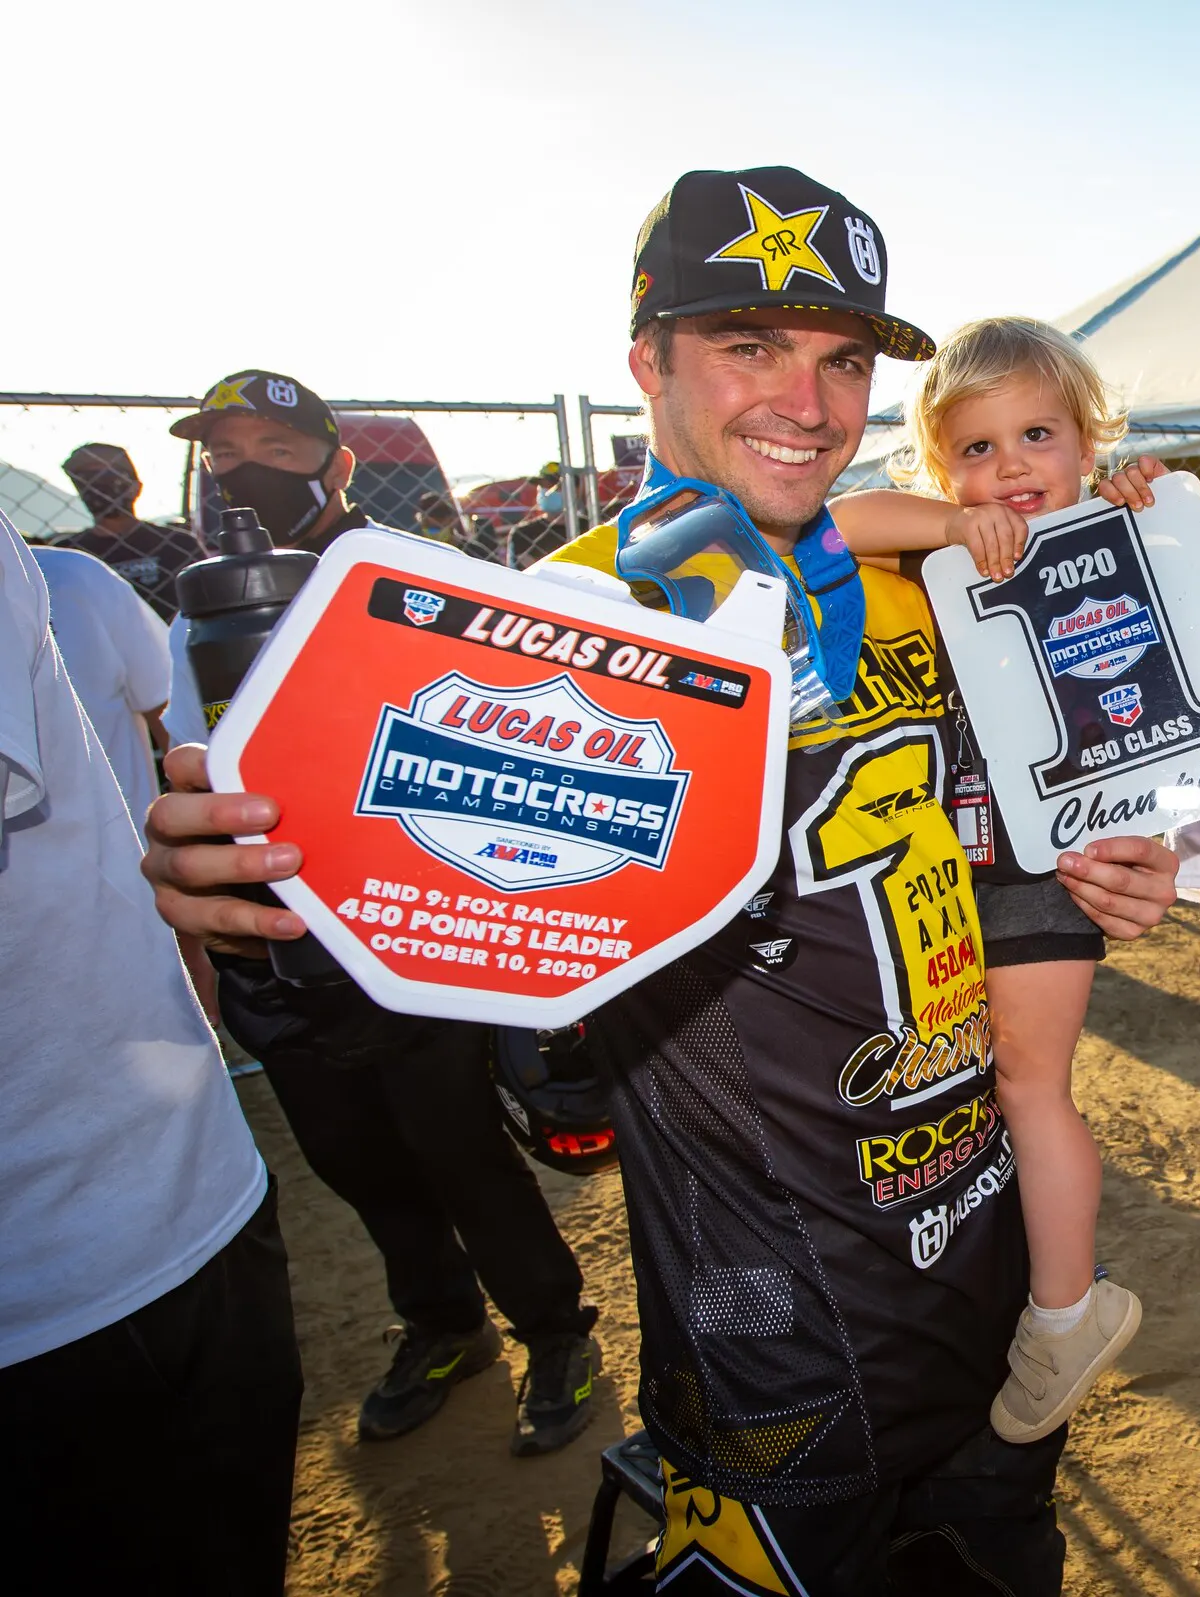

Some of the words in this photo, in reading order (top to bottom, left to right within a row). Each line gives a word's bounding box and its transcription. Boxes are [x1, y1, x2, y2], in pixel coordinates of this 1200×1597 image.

[1038, 547, 1118, 596] 2020
[1057, 608, 1103, 636] LUCAS
[1106, 600, 1130, 620] OIL
[461, 607, 607, 669] LUCAS
[607, 642, 671, 688] OIL
[1050, 620, 1152, 663] MOTOCROSS
[1054, 631, 1154, 669] CHAMPIONSHIP
[678, 671, 722, 692] AMA
[721, 680, 743, 693] PRO
[439, 695, 578, 752] LUCAS
[583, 727, 647, 767] OIL
[1080, 740, 1121, 768] 450
[1124, 715, 1194, 754] CLASS
[383, 749, 668, 831] MOTOCROSS
[502, 761, 575, 785] PRO
[955, 783, 986, 794] MOTOCROSS
[379, 779, 661, 841] CHAMPIONSHIP
[883, 800, 936, 825] RACING
[979, 805, 989, 845] 2020
[473, 842, 530, 864] AMA
[530, 851, 558, 863] PRO
[496, 837, 540, 849] SANCTIONED
[963, 847, 989, 862] UEST
[363, 878, 421, 903] RND
[425, 888, 451, 909] 9:
[455, 895, 510, 920] FOX
[512, 904, 628, 934] RACEWAY
[905, 858, 959, 913] 2020
[336, 897, 404, 928] 450
[409, 910, 524, 947] POINTS
[528, 929, 633, 960] LEADER
[369, 933, 488, 967] OCTOBER
[496, 953, 530, 975] 10,
[539, 958, 597, 980] 2020
[876, 1128, 989, 1203] ENERGY
